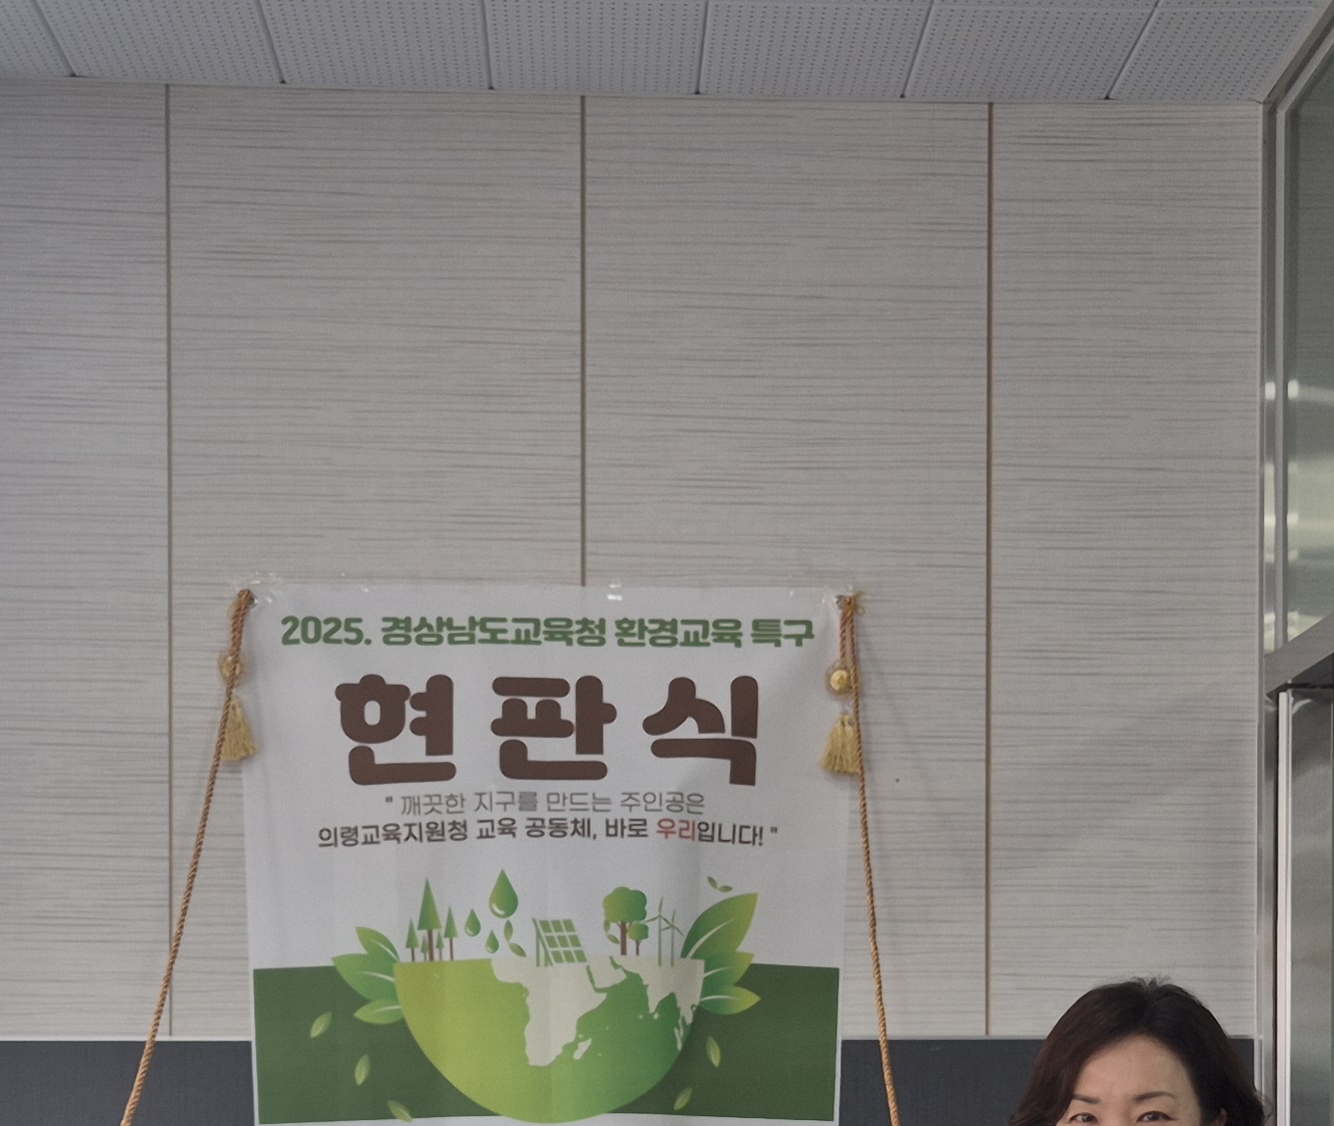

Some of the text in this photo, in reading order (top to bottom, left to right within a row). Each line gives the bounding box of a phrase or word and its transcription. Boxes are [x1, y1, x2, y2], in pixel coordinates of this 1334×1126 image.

[281, 615, 815, 648] 2025. 경상남도교육청 환경교육 특구
[474, 791, 538, 812] 지구를
[546, 791, 612, 812] 만드는
[620, 791, 705, 815] 주인공은
[318, 820, 469, 848] 의령교육지원청
[476, 817, 518, 840] 교육
[525, 817, 597, 840] 공동체,
[605, 818, 648, 839] 바로
[656, 817, 763, 847] 우리입니다!
